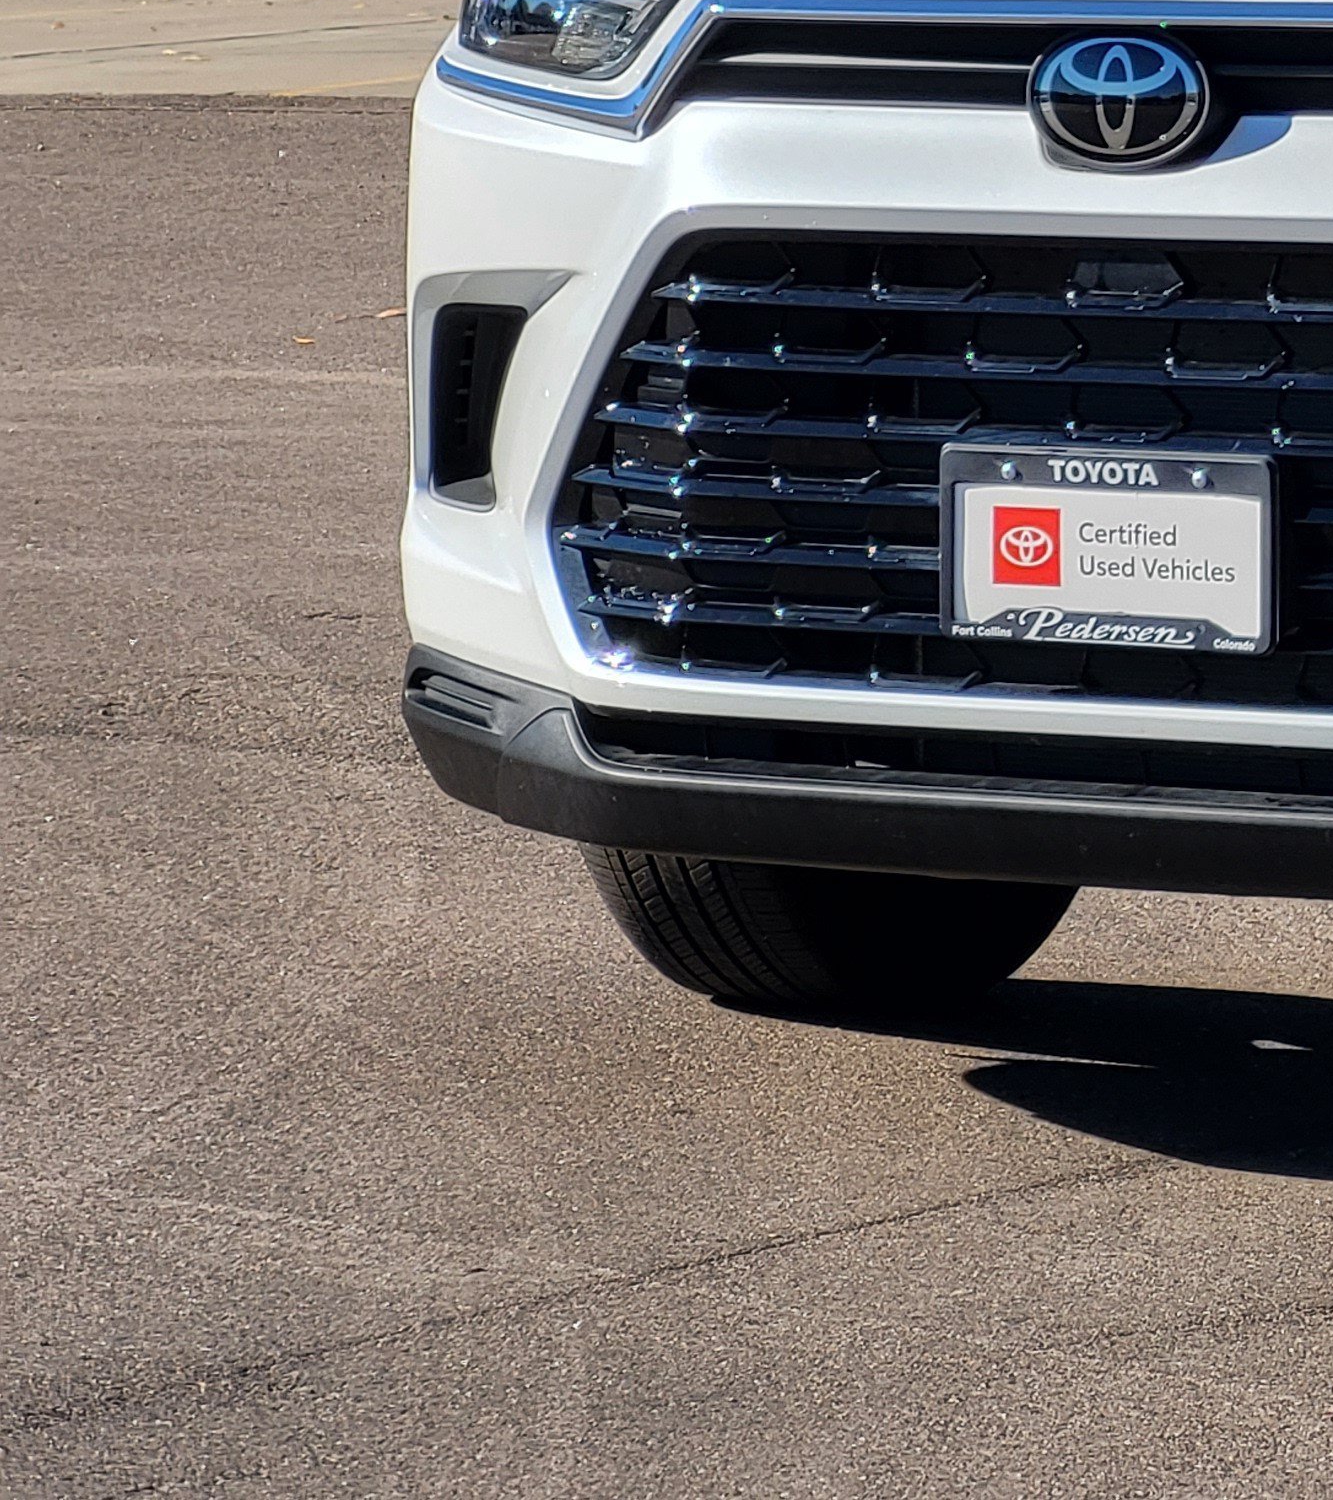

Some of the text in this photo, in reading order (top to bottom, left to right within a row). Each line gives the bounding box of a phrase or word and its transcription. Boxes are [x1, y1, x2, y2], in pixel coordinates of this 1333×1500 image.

[1047, 459, 1160, 487] TOYOTA
[1078, 522, 1177, 547] Certified
[1079, 555, 1236, 583] Used Vehicles
[952, 624, 1013, 638] Fort Collins
[1018, 606, 1196, 646] Pedersen
[1212, 637, 1256, 652] Colorado
